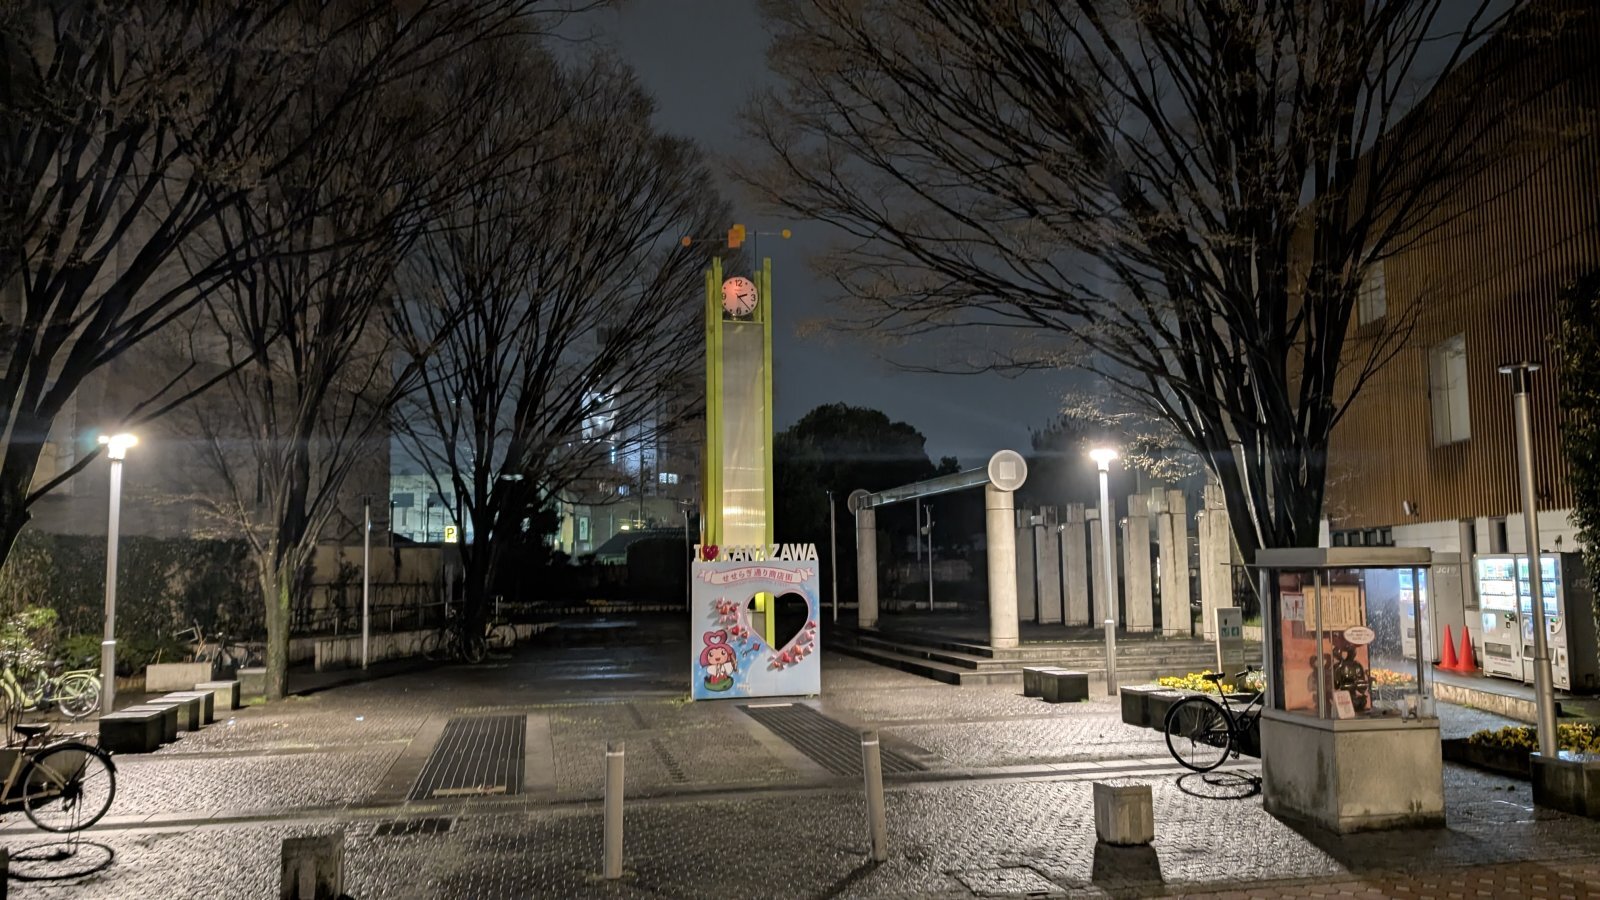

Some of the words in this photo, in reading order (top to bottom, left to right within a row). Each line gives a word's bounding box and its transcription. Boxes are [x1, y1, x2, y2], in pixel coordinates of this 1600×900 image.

[735, 279, 743, 287] 12
[447, 527, 454, 539] P
[693, 544, 701, 561] I
[720, 543, 818, 561] KANAZAWA
[723, 568, 793, 582] せせらぎ通り商店街
